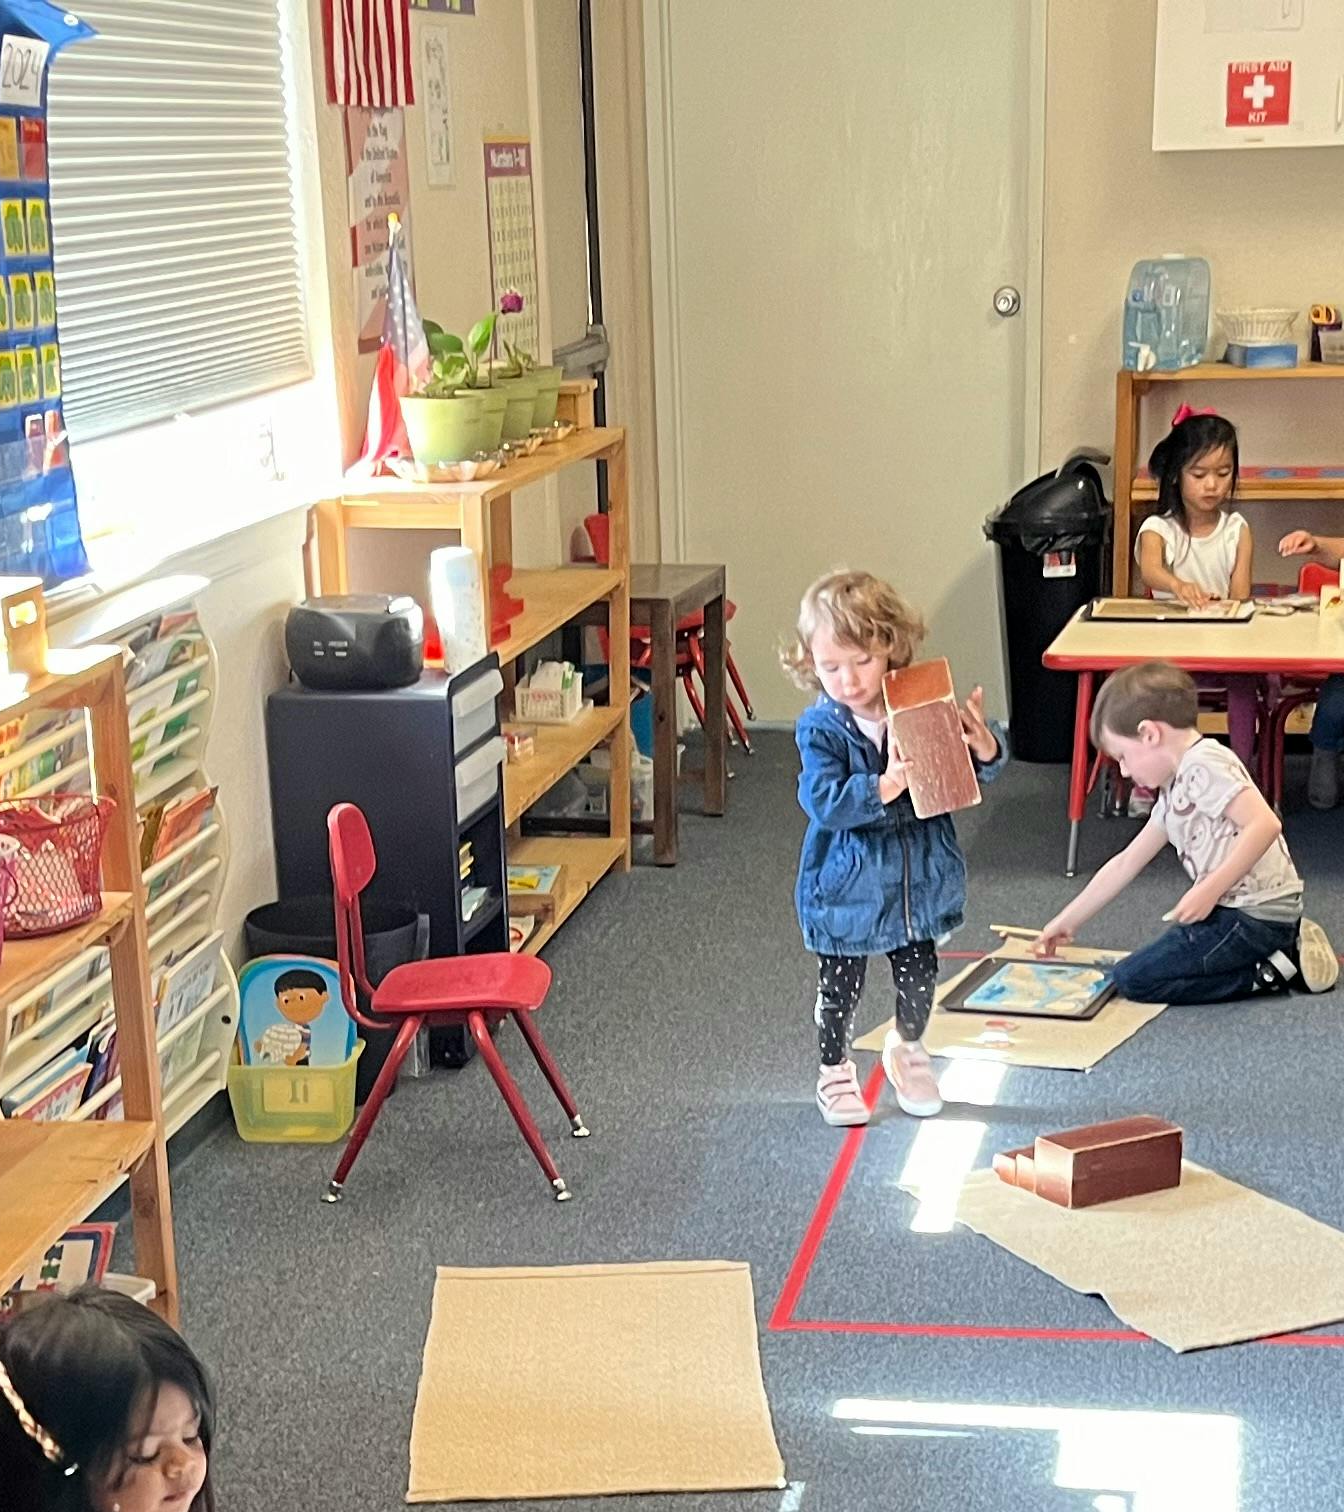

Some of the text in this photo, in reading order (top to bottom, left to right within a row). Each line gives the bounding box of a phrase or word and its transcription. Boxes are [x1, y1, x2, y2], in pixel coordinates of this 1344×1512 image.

[1, 42, 44, 95] 2024
[1231, 60, 1290, 75] FIRST AID
[1247, 111, 1268, 125] KIT
